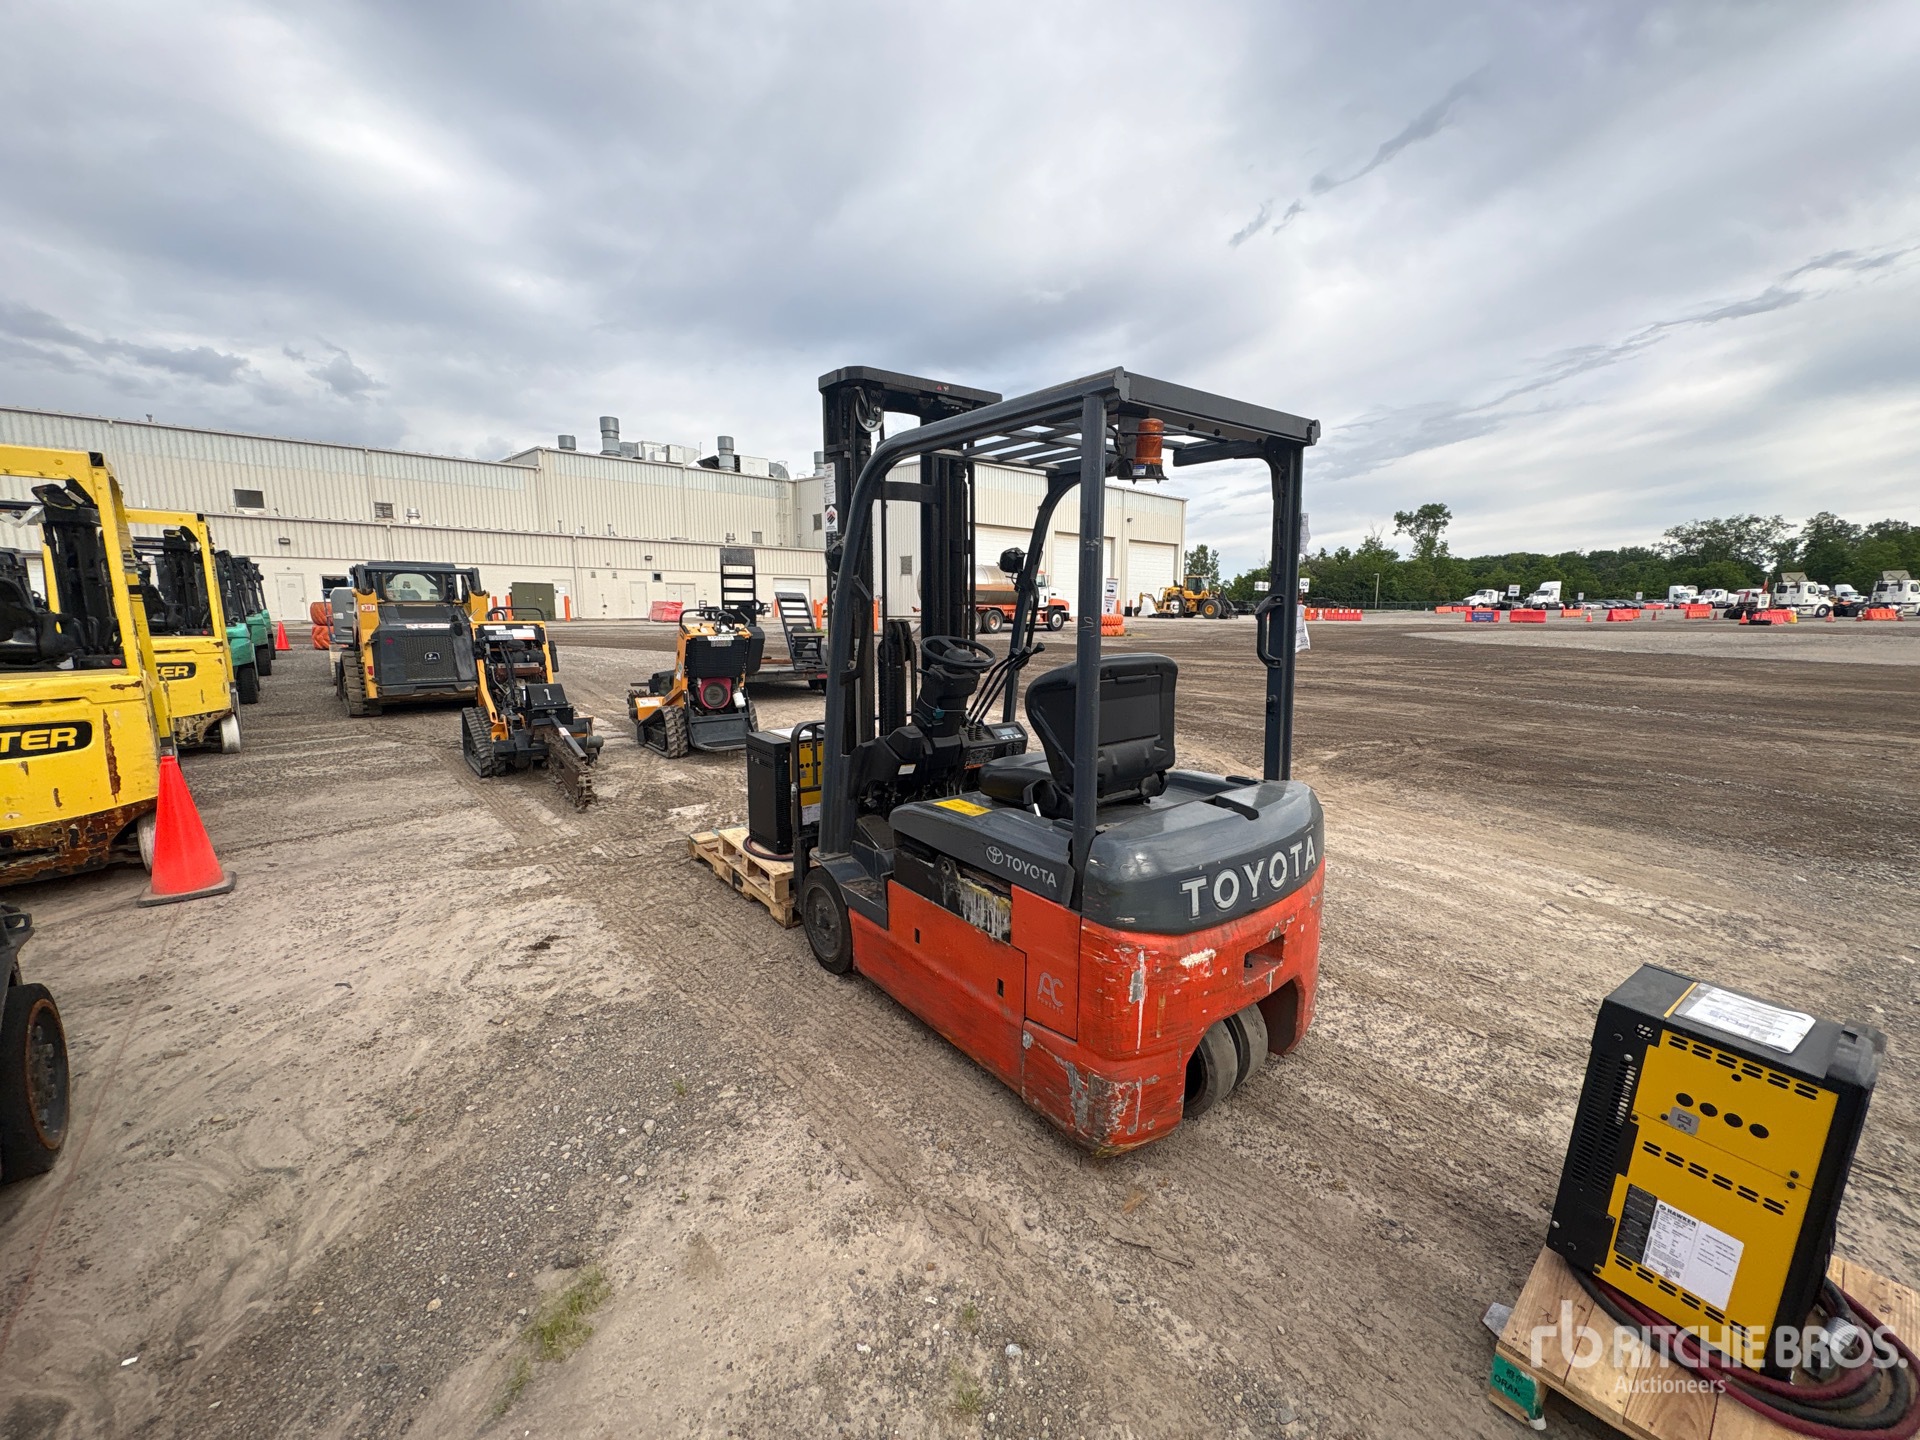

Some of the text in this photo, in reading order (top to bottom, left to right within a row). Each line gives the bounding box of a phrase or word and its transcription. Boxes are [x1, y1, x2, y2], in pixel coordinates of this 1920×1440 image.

[1005, 854, 1057, 888] TOYOTA
[1182, 835, 1316, 917] TOYOTA
[1667, 1208, 1697, 1227] HAWKER
